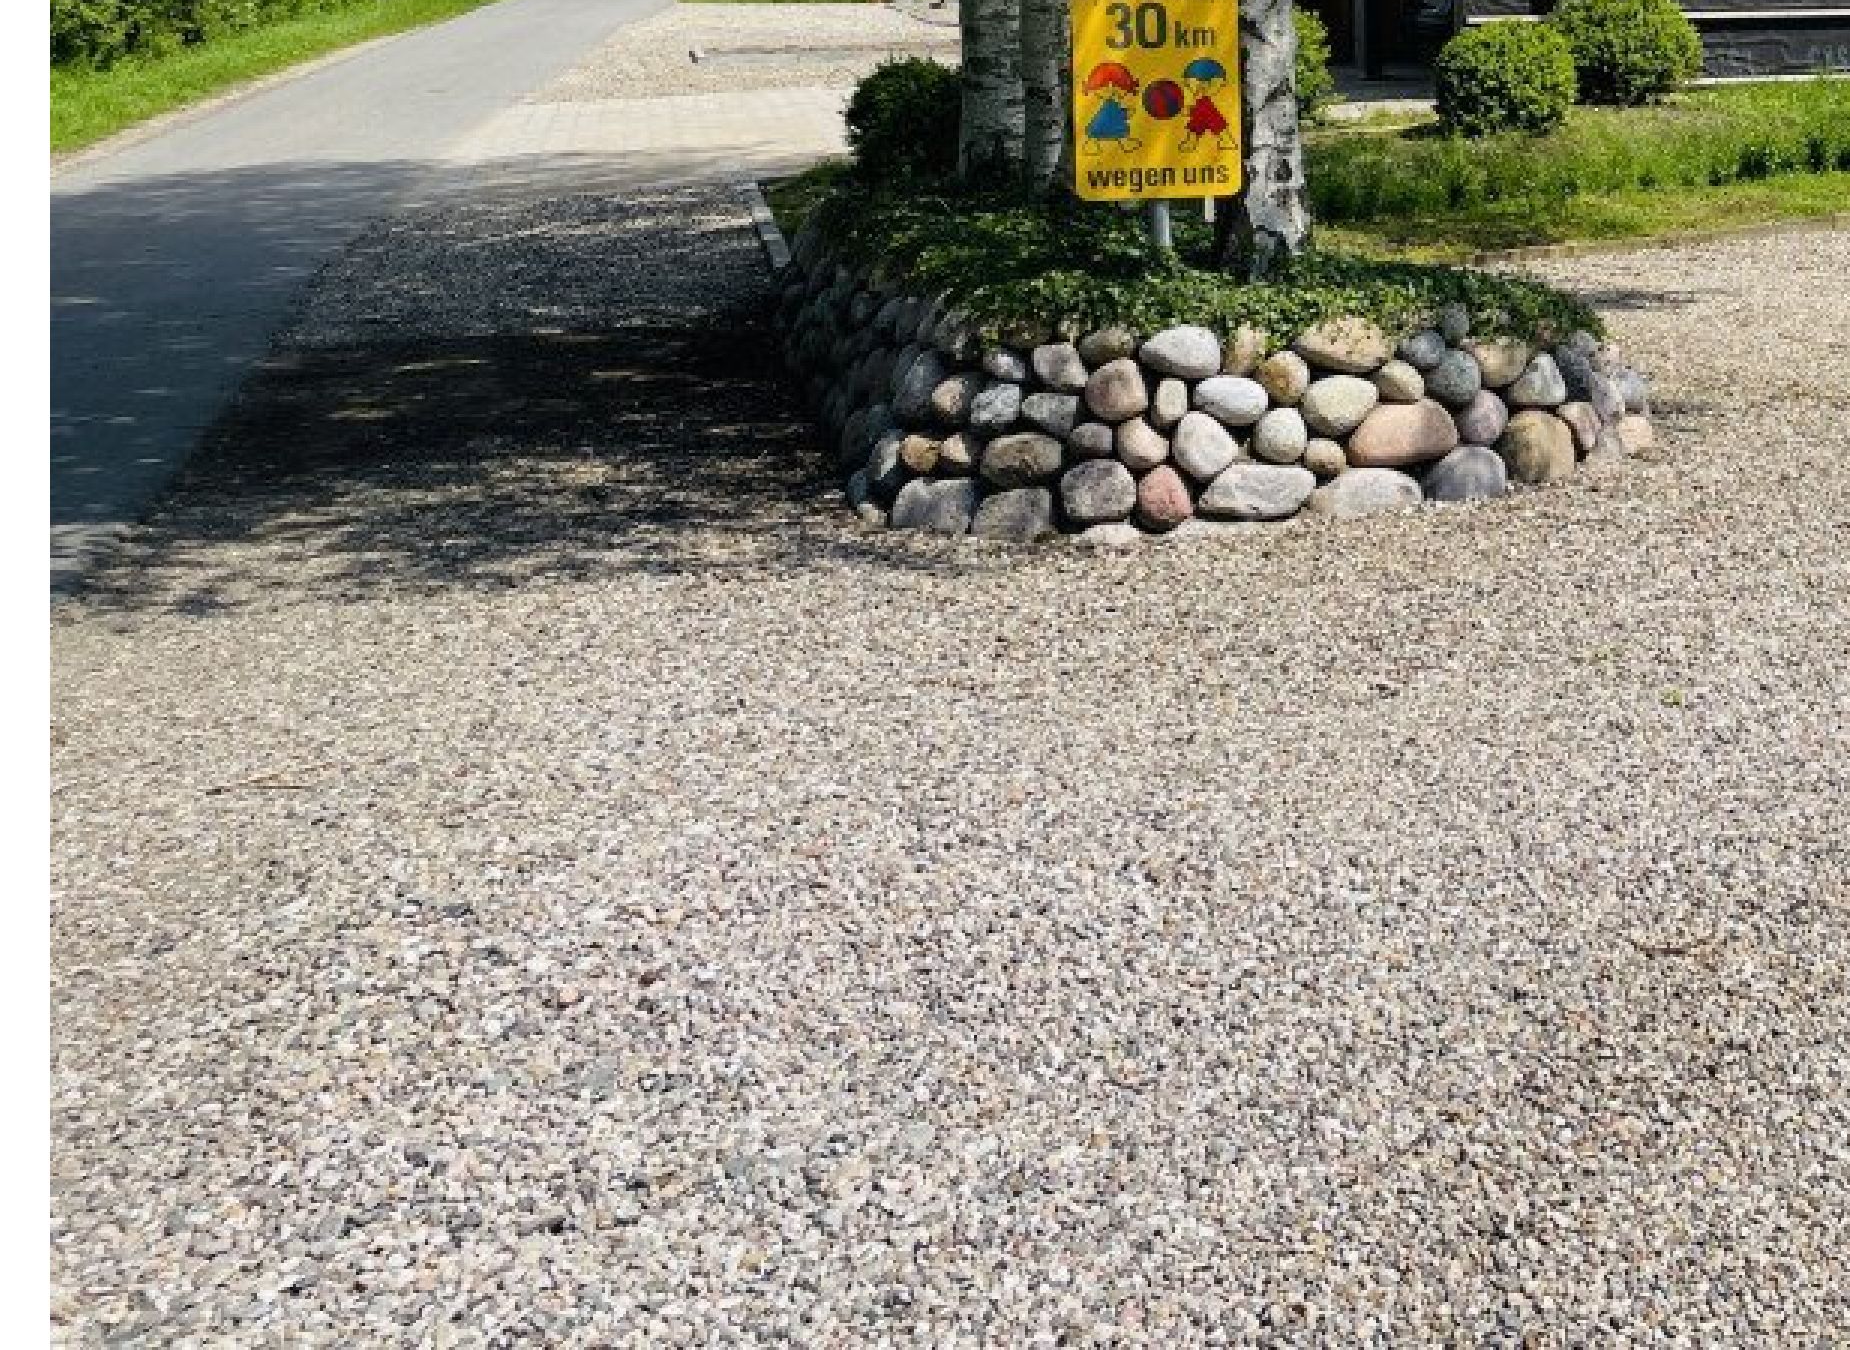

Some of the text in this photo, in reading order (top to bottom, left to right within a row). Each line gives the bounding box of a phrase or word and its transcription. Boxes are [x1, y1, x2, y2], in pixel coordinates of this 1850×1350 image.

[1105, 2, 1216, 50] 30 km
[1086, 165, 1230, 193] wegen uns
